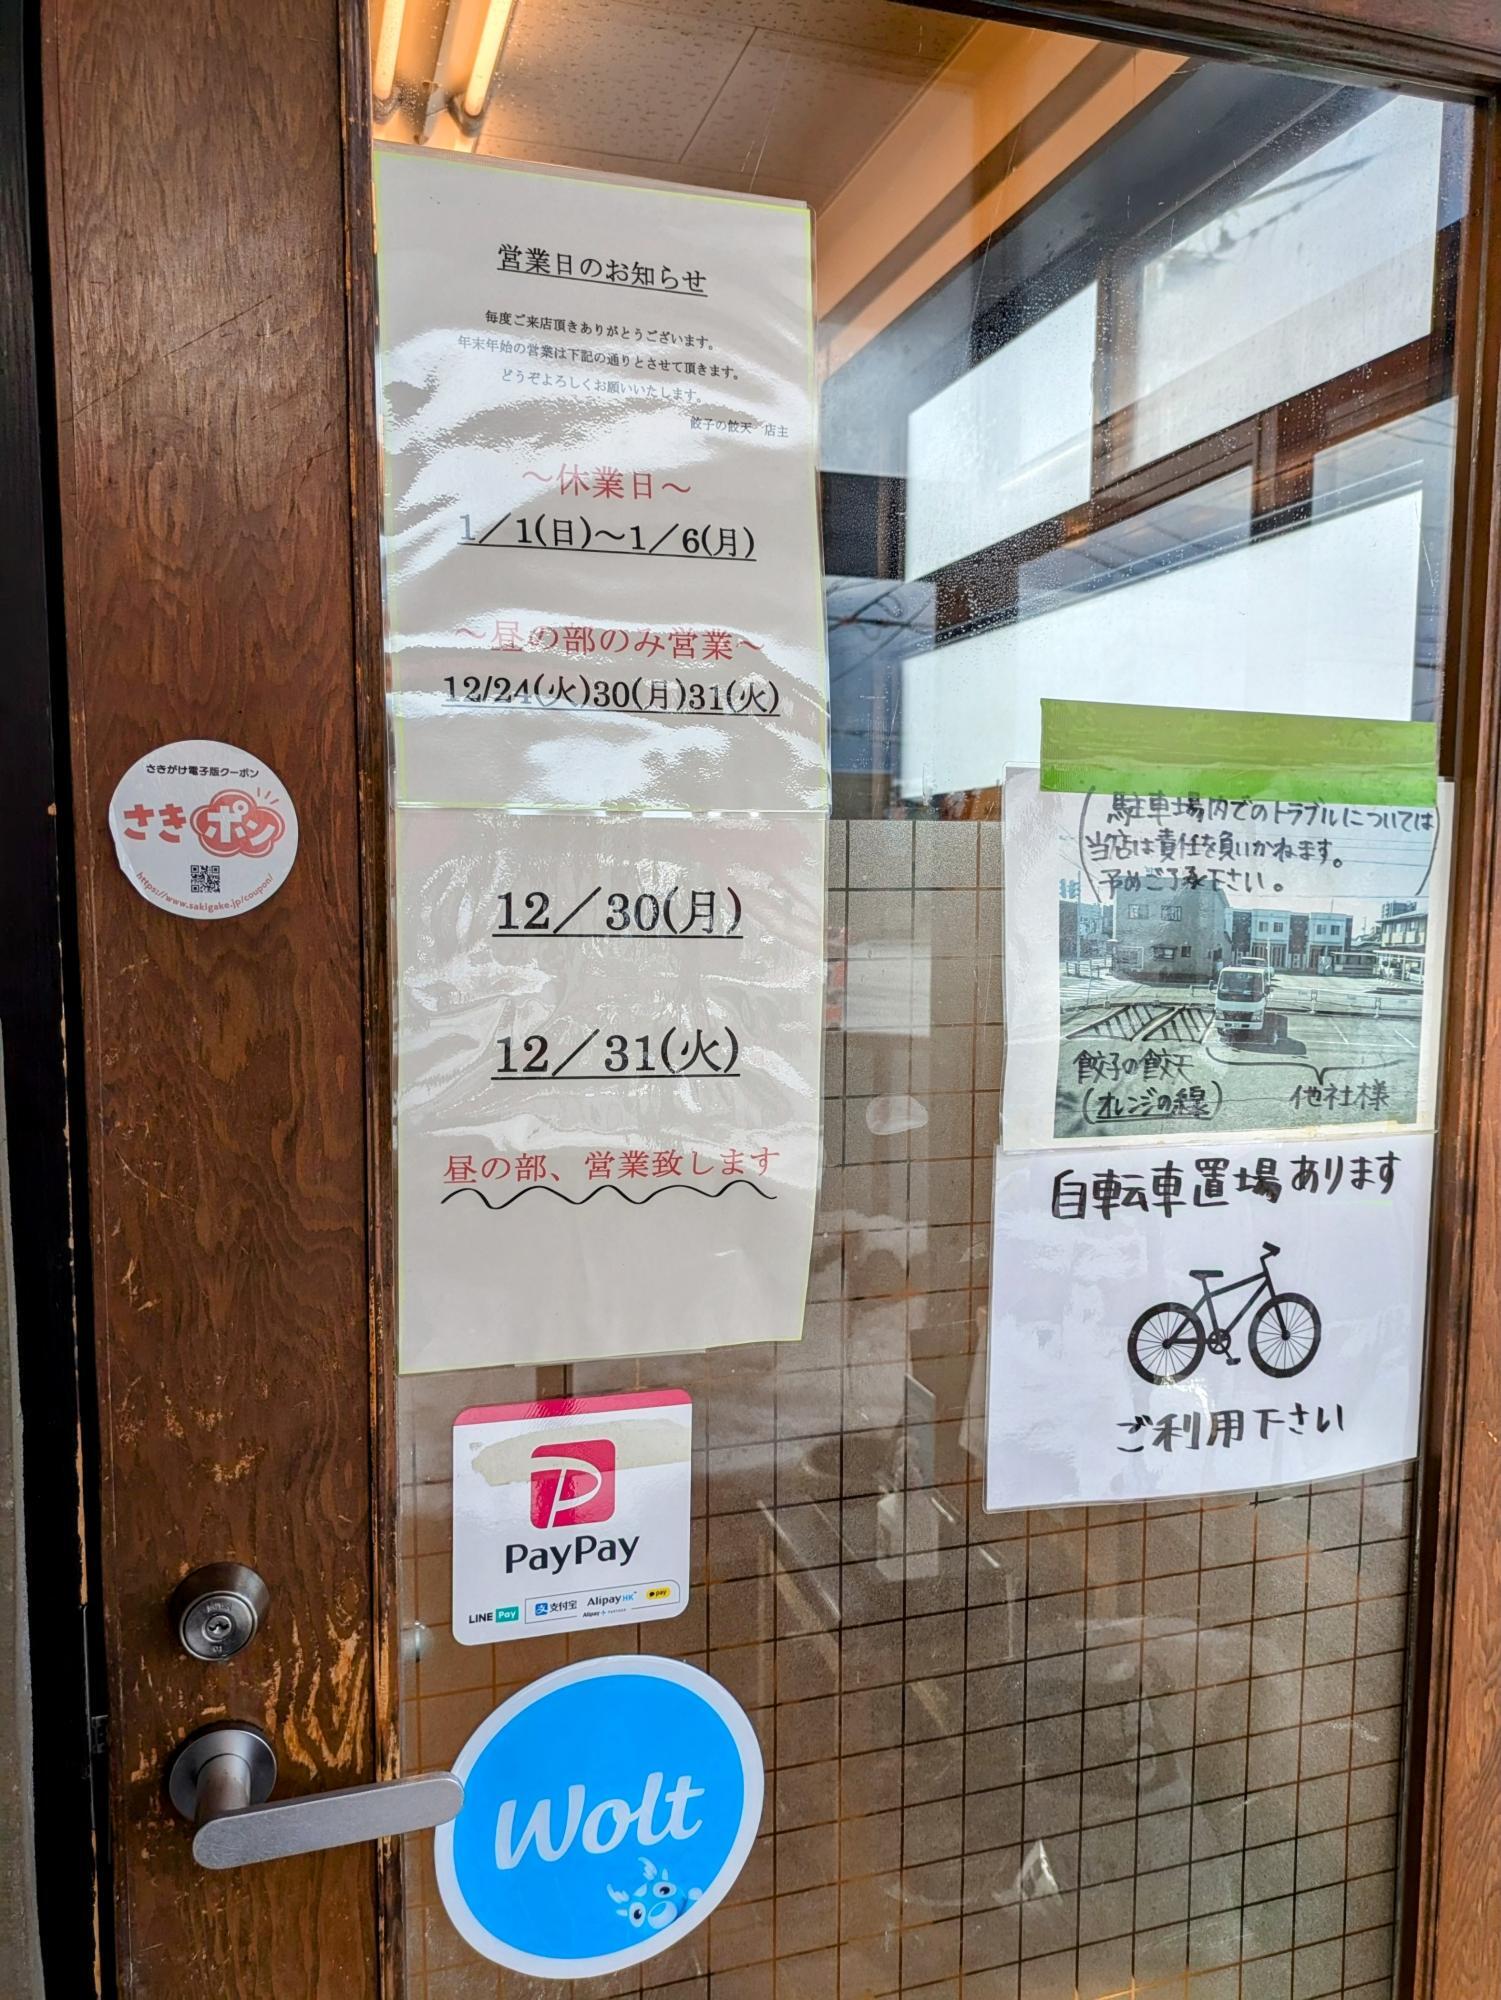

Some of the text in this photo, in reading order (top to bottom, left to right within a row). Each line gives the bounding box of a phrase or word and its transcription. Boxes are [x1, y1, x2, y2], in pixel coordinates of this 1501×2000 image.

[498, 244, 707, 294] 営業日のお知らせ
[485, 310, 713, 351] 毎度ご来店頂きありがとうございます。
[458, 335, 738, 380] 年末年始の営業は下記の通りとさせて頂きます。
[502, 368, 701, 403] どうぞよろしくお願いいたします。
[146, 763, 259, 778] さきがけ電子版クーポン
[1107, 789, 1434, 832] 駐車場内でのトラブルについては
[1086, 828, 1343, 868] 当店は責任を負いかねます。
[1099, 864, 1283, 899] 予めご了承下さい。
[1289, 1080, 1389, 1110] 他社様
[443, 1147, 780, 1184] 昼の部、営業致します
[1116, 1402, 1344, 1452] ご利用下さい
[505, 1535, 640, 1575] PayPay
[469, 1610, 516, 1624] LINE Pay
[494, 1771, 705, 1870] Wolt
